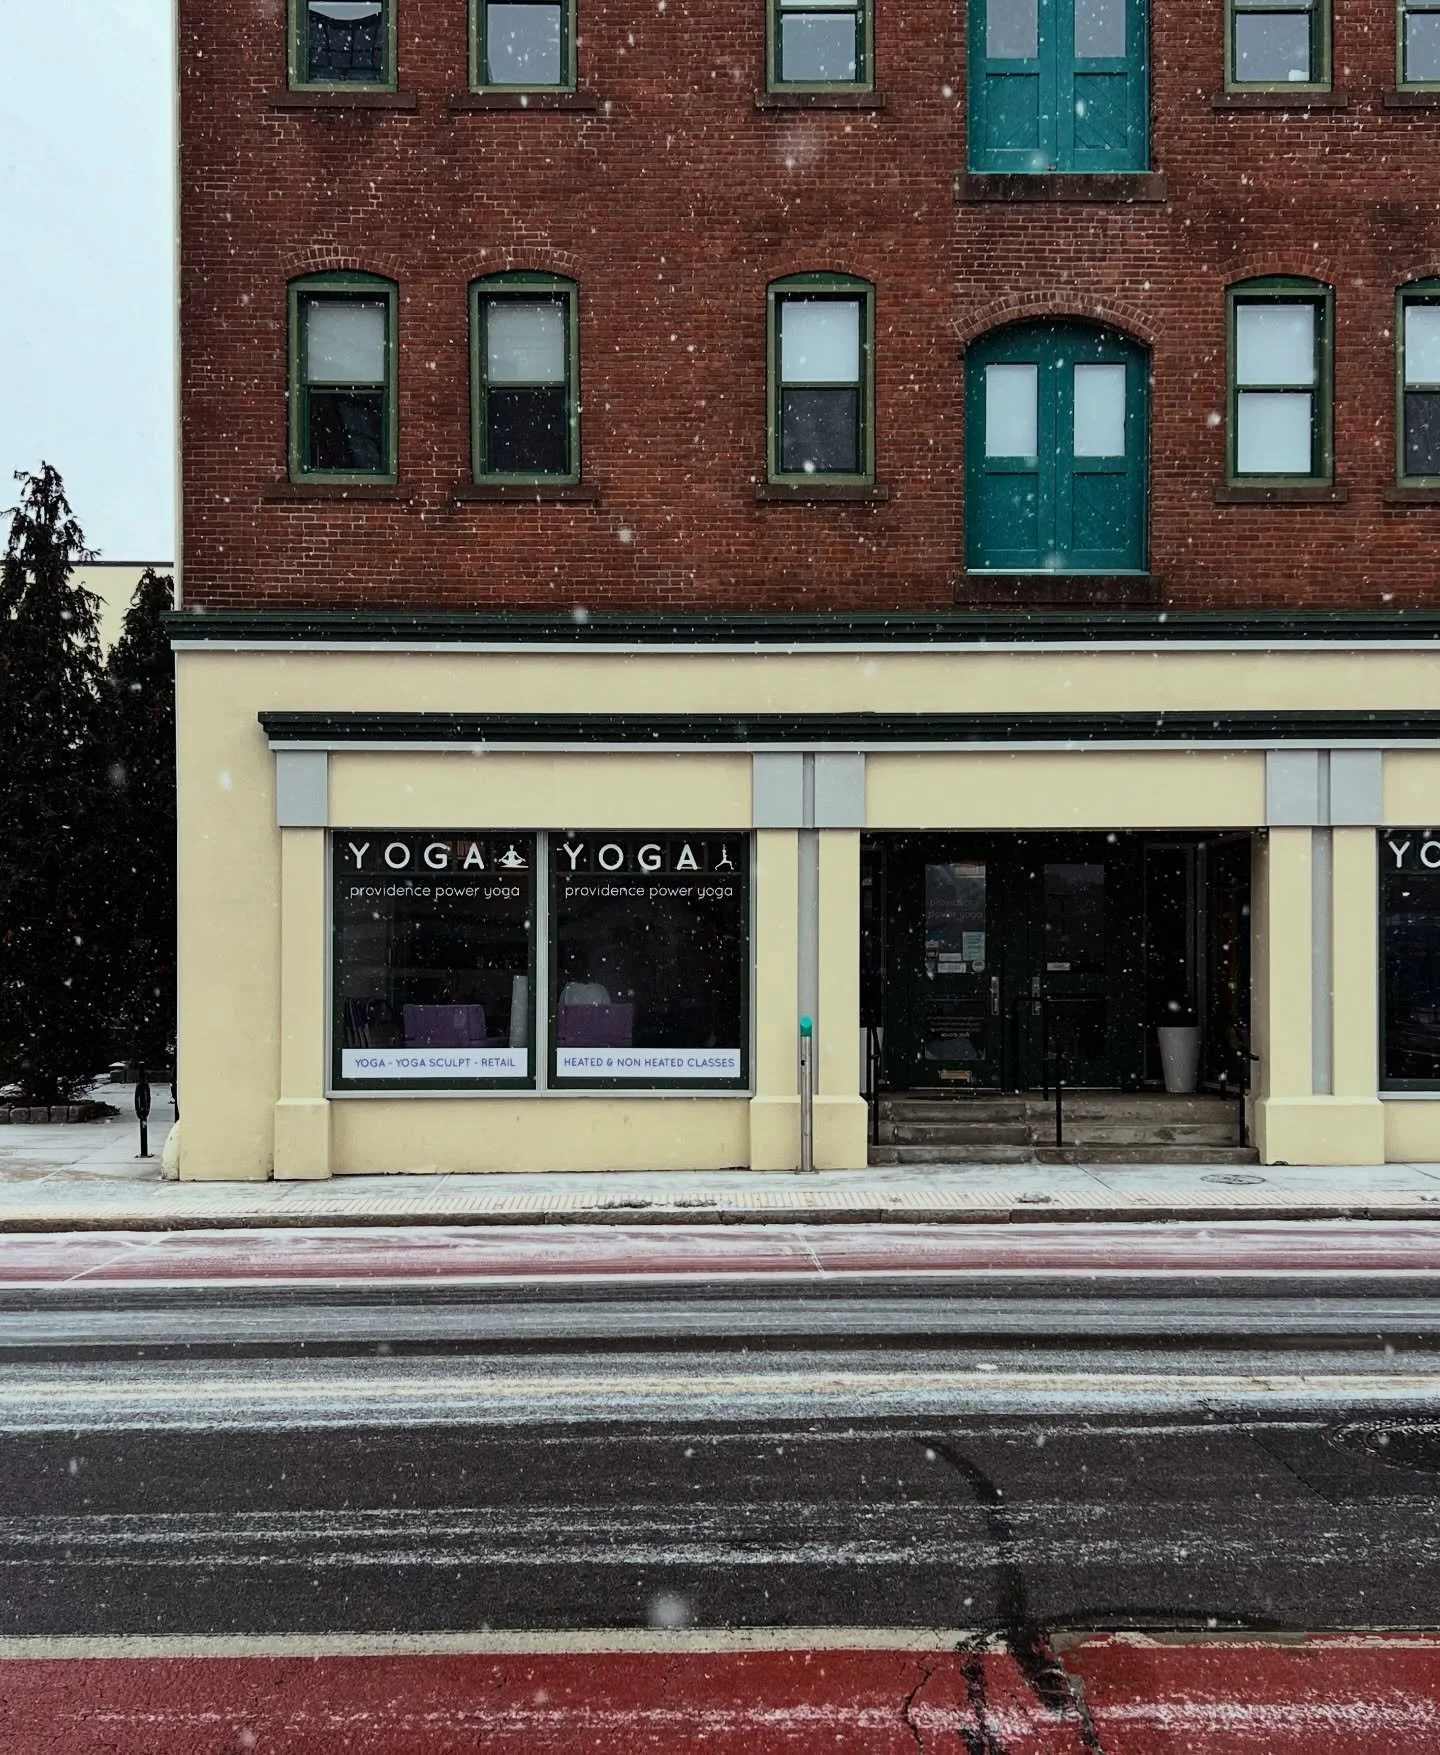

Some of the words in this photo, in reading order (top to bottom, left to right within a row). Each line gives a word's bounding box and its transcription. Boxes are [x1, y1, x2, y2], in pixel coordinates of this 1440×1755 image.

[348, 841, 485, 870] YOGA
[562, 843, 698, 871] YOGA
[350, 884, 431, 898] providence
[435, 886, 480, 898] power
[484, 886, 520, 899] yoga
[565, 884, 645, 898] providence
[649, 886, 692, 898] power
[697, 886, 733, 899] yoga
[355, 1058, 386, 1068] YOGA
[395, 1058, 426, 1067] YOGA
[429, 1058, 470, 1067] SCULPT
[481, 1057, 516, 1067] RETAIL
[564, 1057, 603, 1067] HEATED
[606, 1057, 613, 1067] &
[617, 1057, 641, 1067] NON
[645, 1057, 684, 1067] HEATED
[687, 1057, 735, 1068] CLASSES
